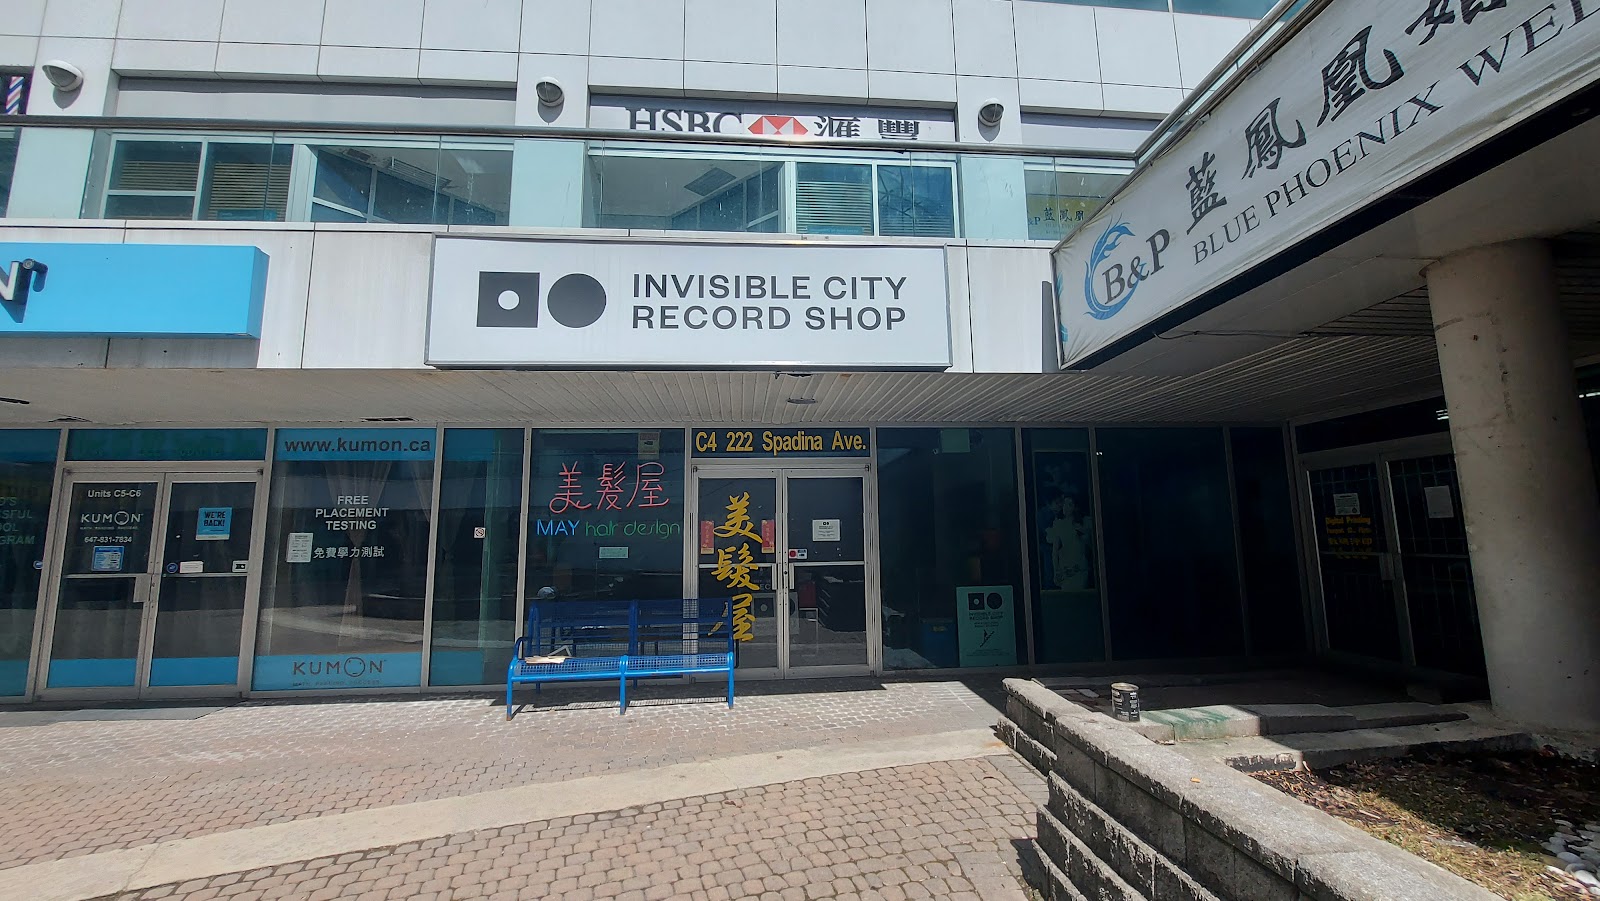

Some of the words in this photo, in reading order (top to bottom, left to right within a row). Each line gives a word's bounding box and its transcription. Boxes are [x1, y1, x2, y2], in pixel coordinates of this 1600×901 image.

[626, 107, 743, 133] HSBC
[1193, 205, 1261, 266] BLUE
[1263, 80, 1445, 219] PHOENIX
[1101, 229, 1171, 305] B&P
[632, 273, 811, 300] INVISIBLE
[823, 275, 908, 301] CITY
[632, 305, 792, 330] RECORD
[805, 306, 907, 331] SHOP
[285, 437, 431, 452] www.kumon.ca
[695, 431, 717, 453] C4
[726, 431, 754, 452] 222
[762, 430, 823, 456] Spadina
[832, 430, 867, 451] Ave.
[87, 489, 111, 498] Units
[114, 489, 141, 498] C5-C6
[549, 460, 670, 514] 美髮屋
[337, 495, 369, 505] FREE
[80, 511, 142, 526] KUMON
[203, 519, 226, 527] BACK!
[315, 507, 390, 518] PLACEMENT
[325, 520, 377, 531] TESTING
[536, 518, 581, 536] MAY
[585, 520, 619, 537] hair
[623, 519, 681, 540] design
[293, 656, 384, 678] KUMON
